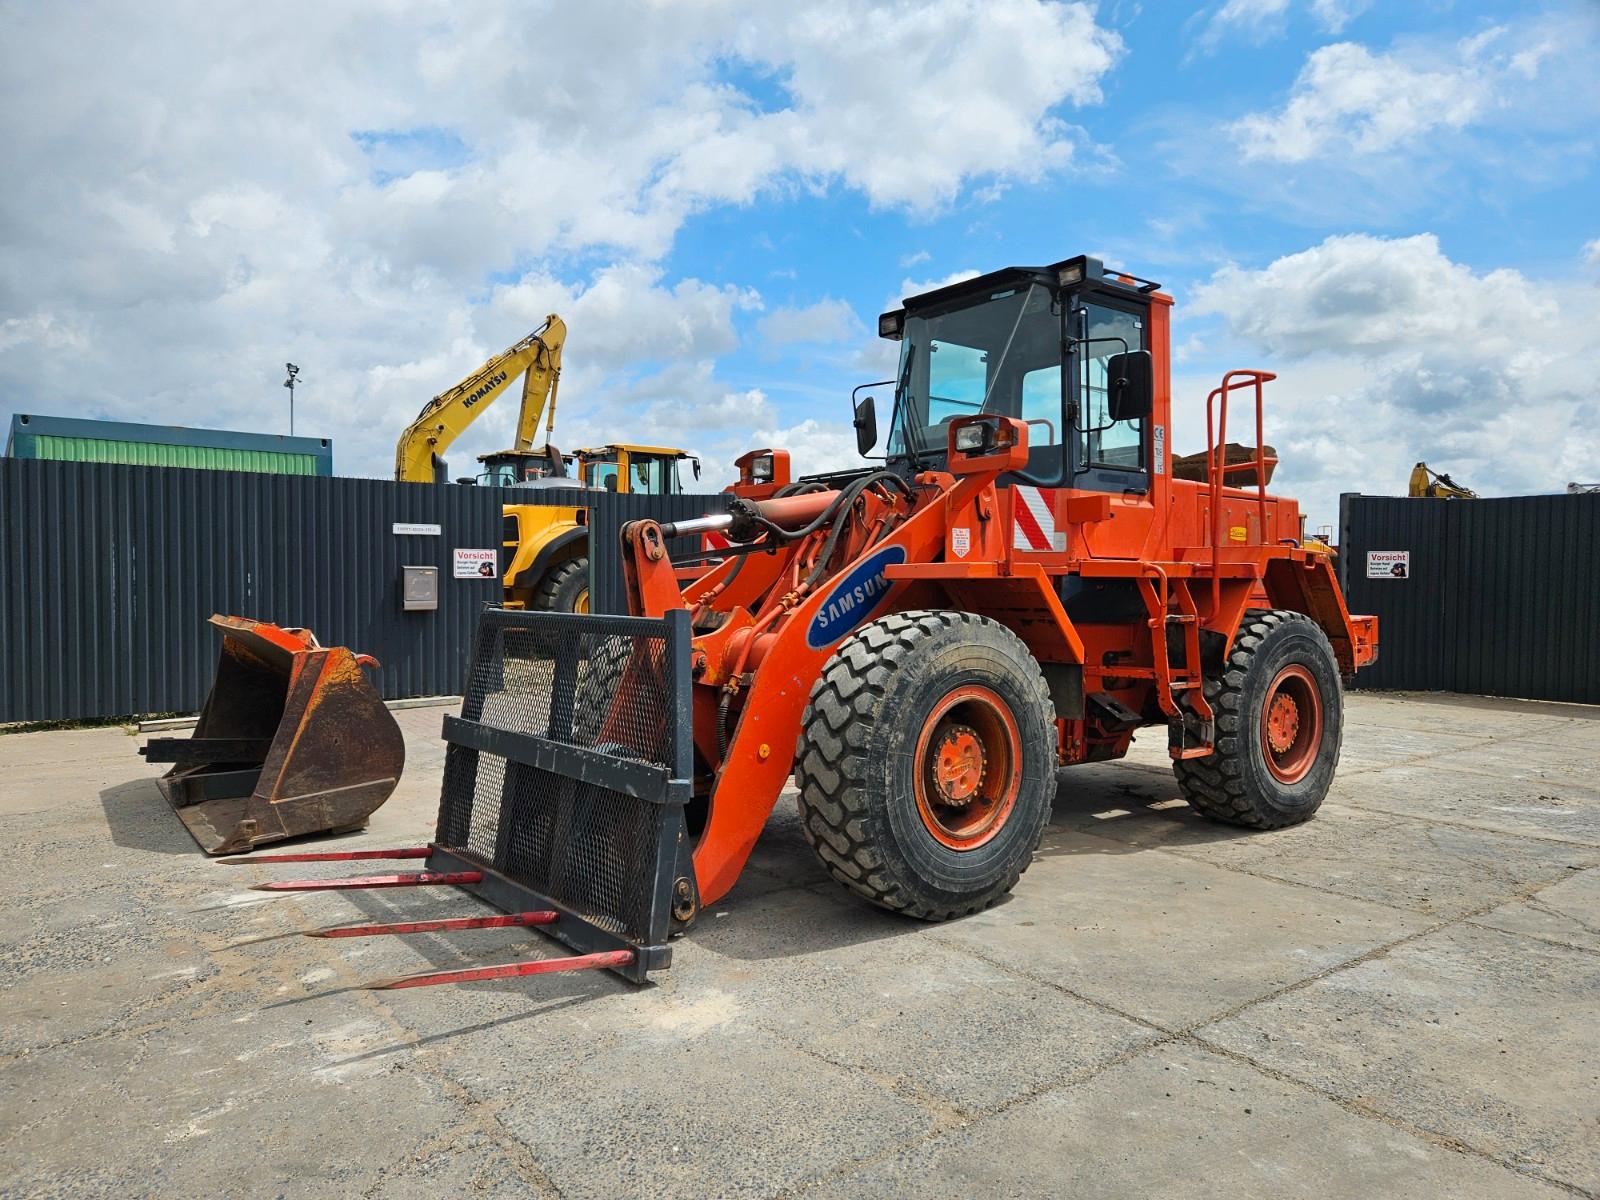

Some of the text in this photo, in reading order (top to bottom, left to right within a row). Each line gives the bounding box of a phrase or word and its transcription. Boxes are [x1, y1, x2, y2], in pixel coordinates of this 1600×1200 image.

[462, 371, 507, 408] KOMATSU
[1154, 427, 1163, 439] CE
[457, 551, 493, 560] Vorsicht
[1371, 553, 1406, 561] Vorsicht
[817, 571, 888, 628] SAMSUN
